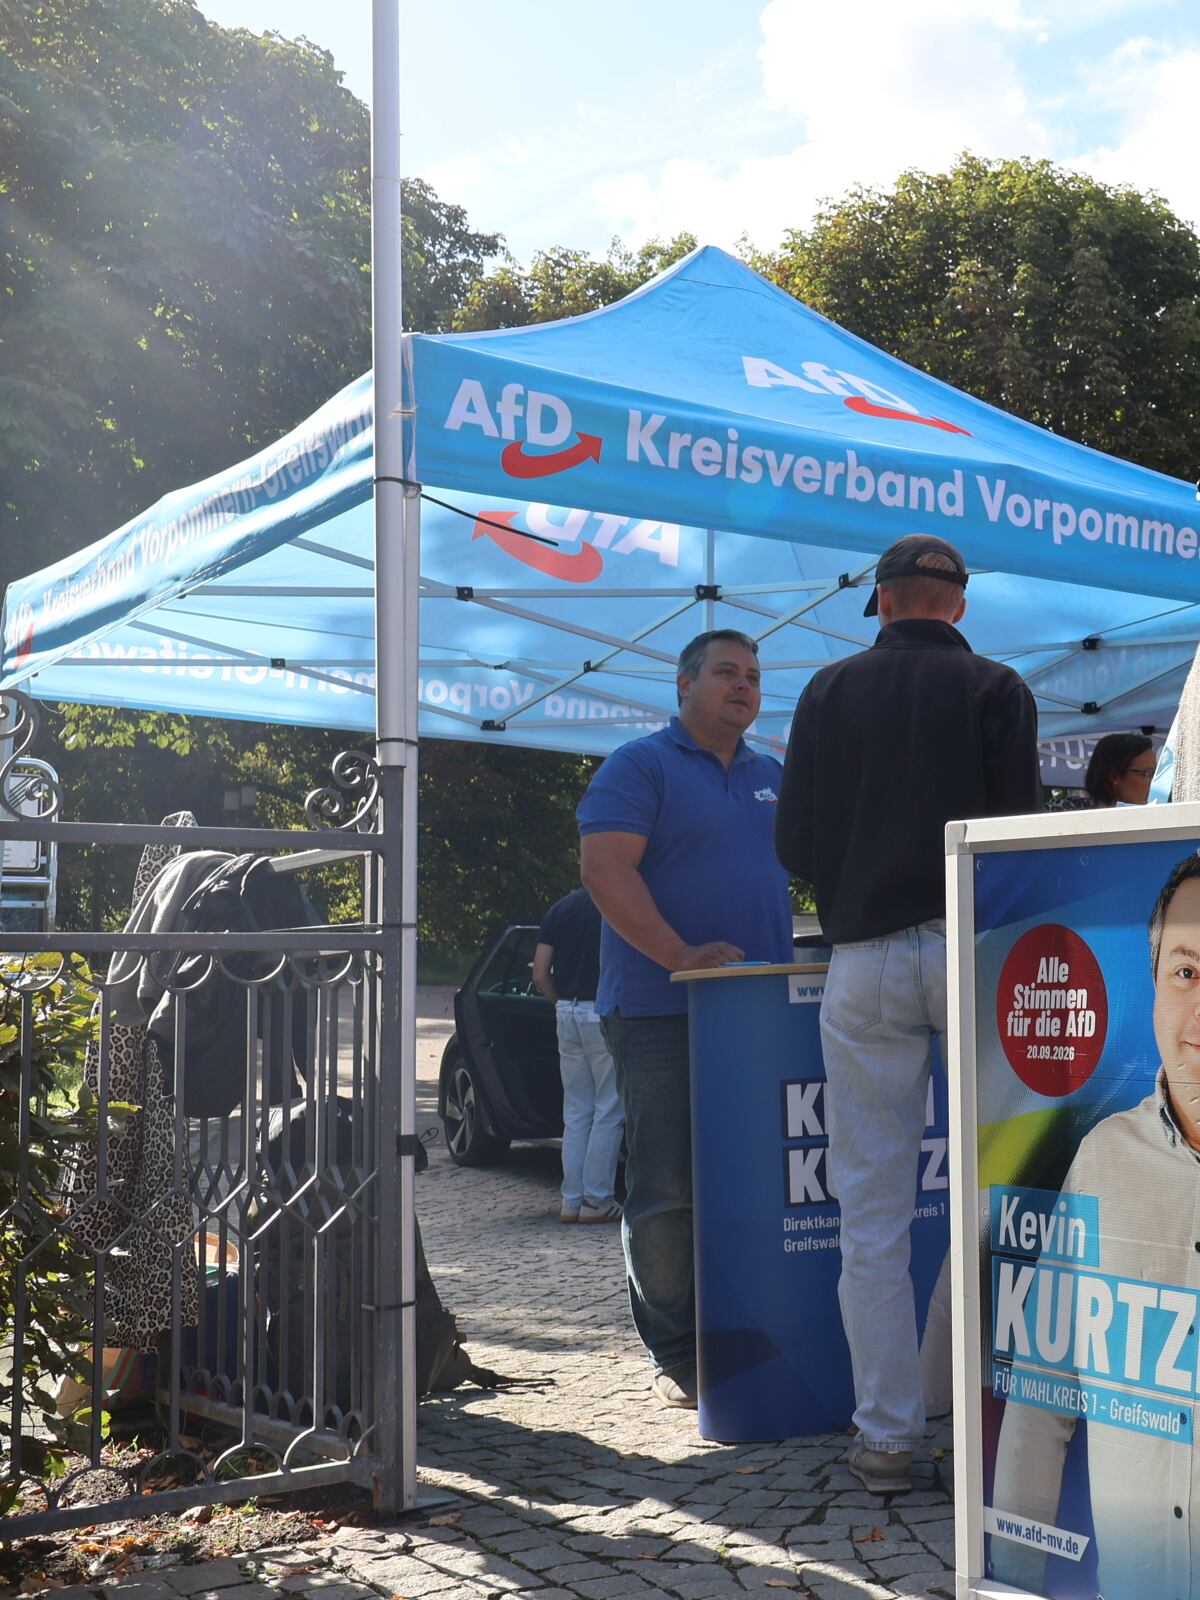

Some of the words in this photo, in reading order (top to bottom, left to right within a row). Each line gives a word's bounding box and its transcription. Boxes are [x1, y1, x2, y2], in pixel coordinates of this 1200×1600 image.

[742, 356, 920, 415] AfD
[444, 378, 573, 447] AfD
[627, 409, 964, 518] Kreisverband
[1037, 956, 1069, 983] Alle
[1013, 982, 1088, 1009] Stimmen
[1007, 1009, 1031, 1037] für
[1035, 1009, 1061, 1037] die
[1065, 1010, 1096, 1037] AfD
[1027, 1045, 1075, 1060] 20.09.2026
[783, 1215, 842, 1231] Direktkan
[940, 1202, 945, 1216] 1
[999, 1194, 1086, 1258] Kevin
[995, 1368, 1017, 1394] FÜR
[1021, 1377, 1088, 1413] WAHLKREIS
[1091, 1394, 1097, 1415] 1
[1110, 1398, 1181, 1435] Greifswald
[996, 1517, 1080, 1555] www.afd-mv.de
